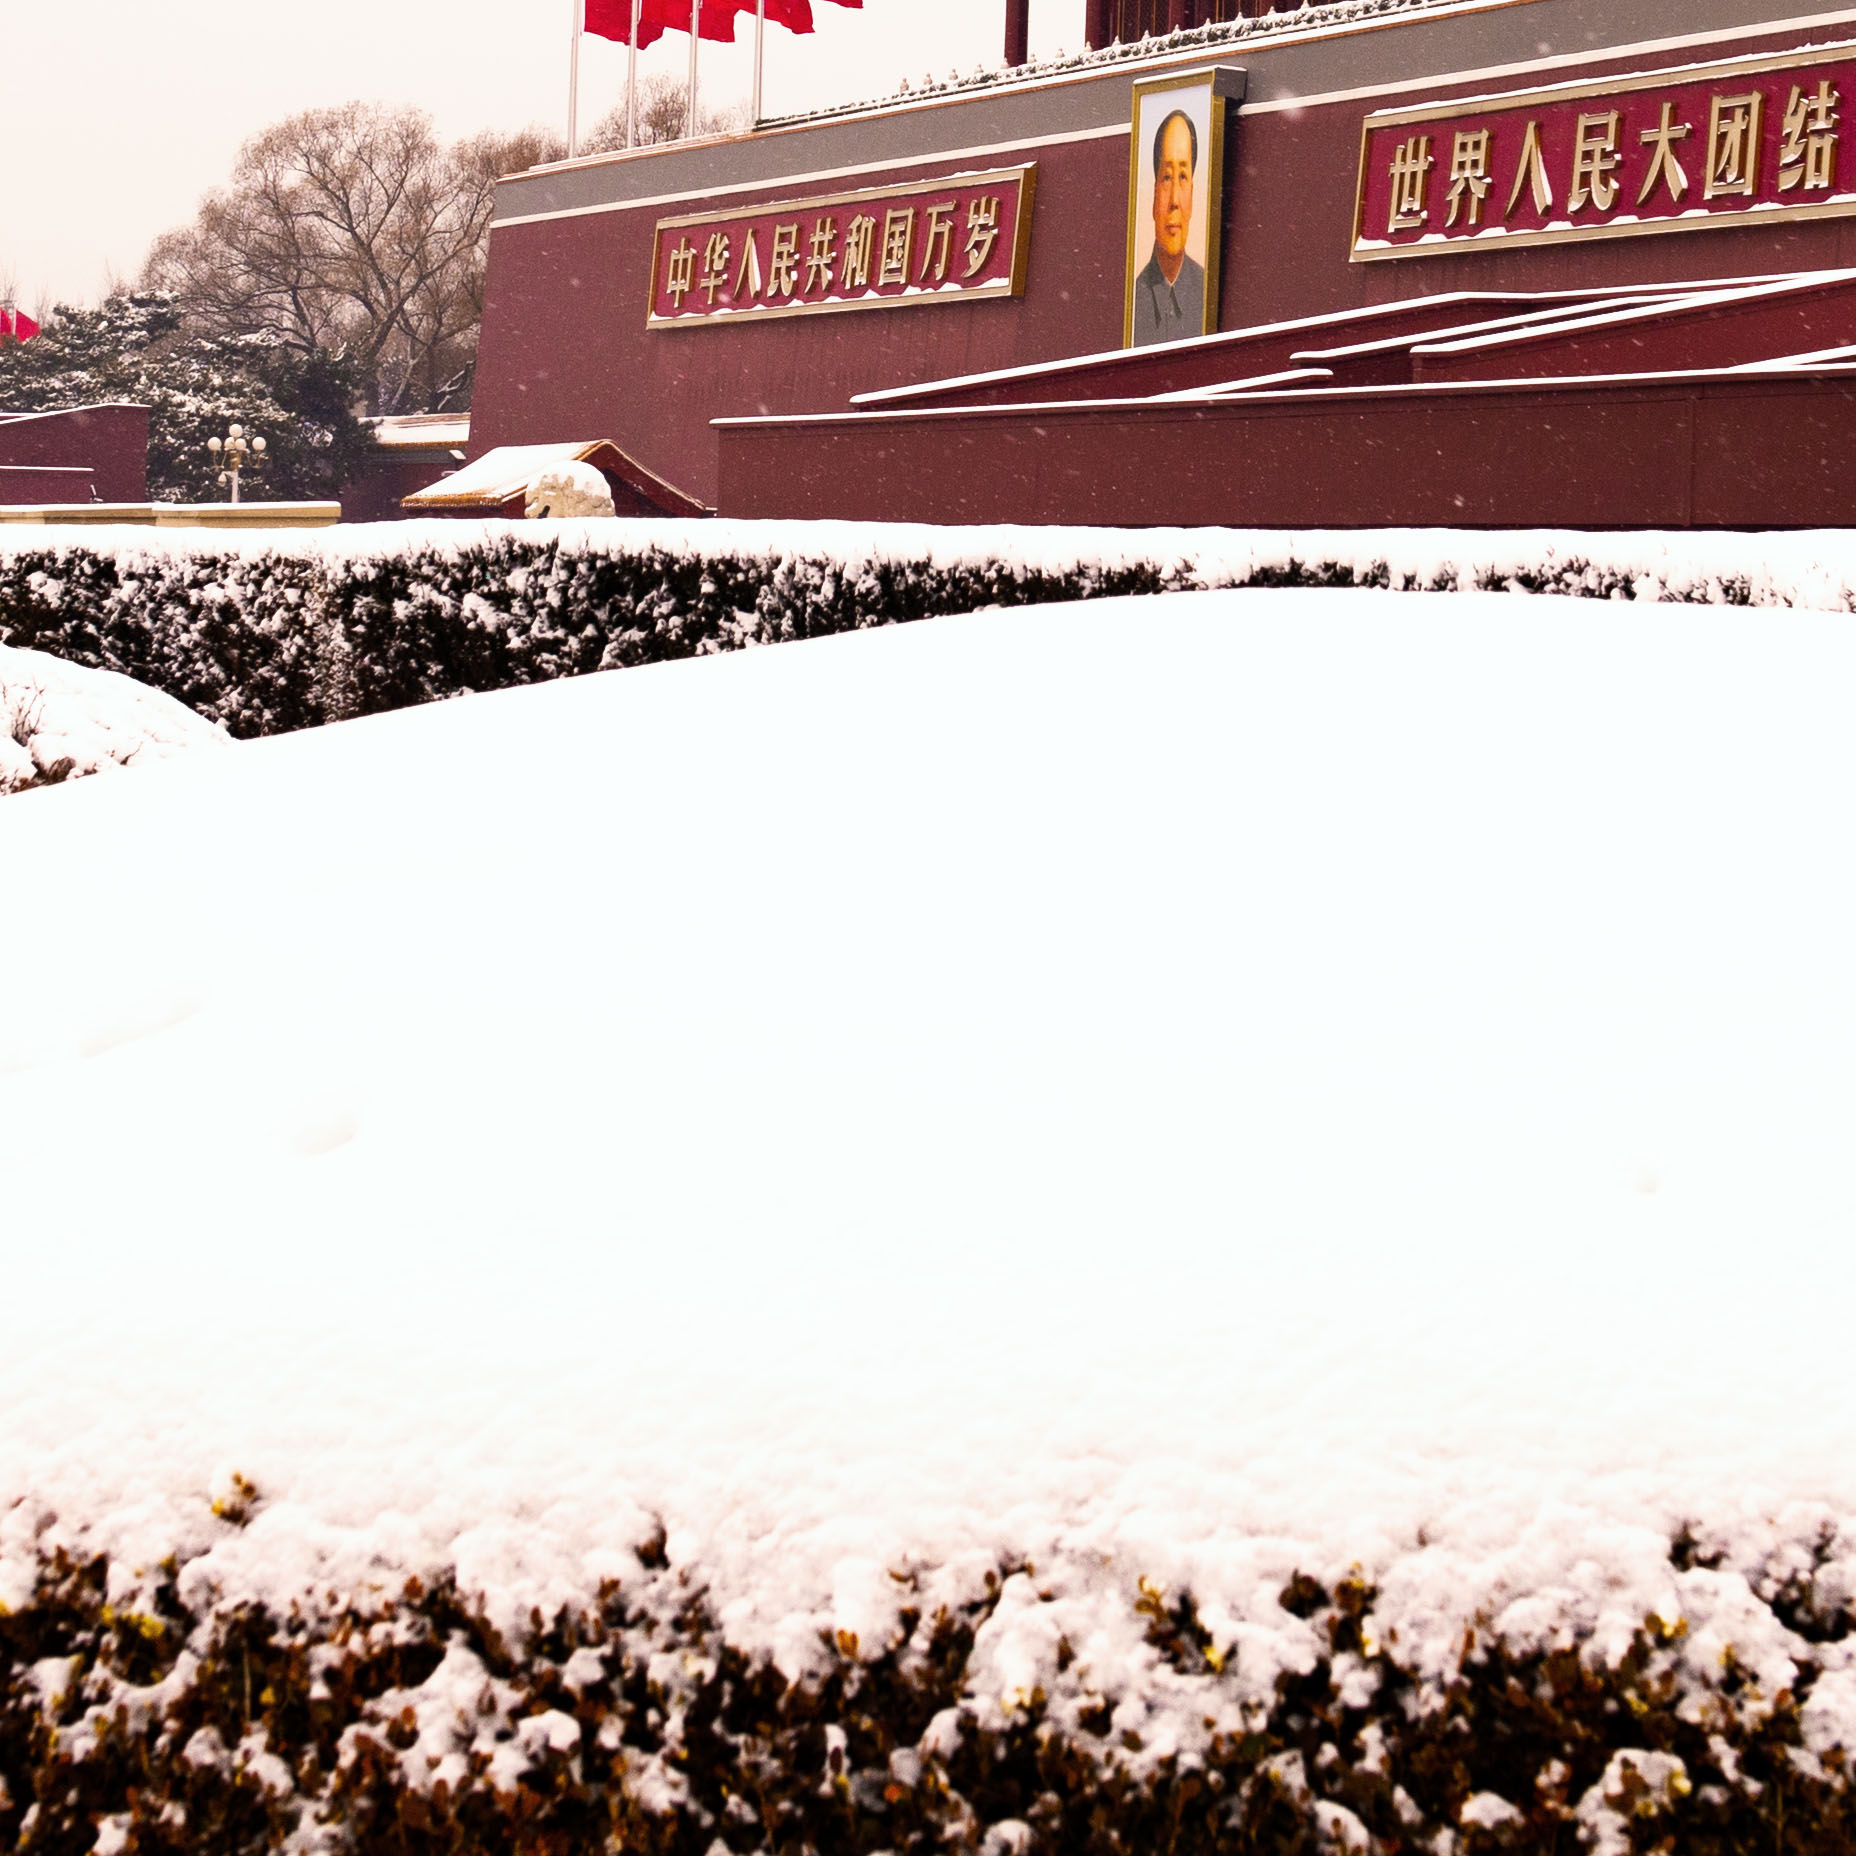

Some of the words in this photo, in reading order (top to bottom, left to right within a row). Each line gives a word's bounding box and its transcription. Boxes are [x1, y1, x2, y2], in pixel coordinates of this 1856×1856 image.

[666, 195, 1000, 308] 中华人民共和国万岁
